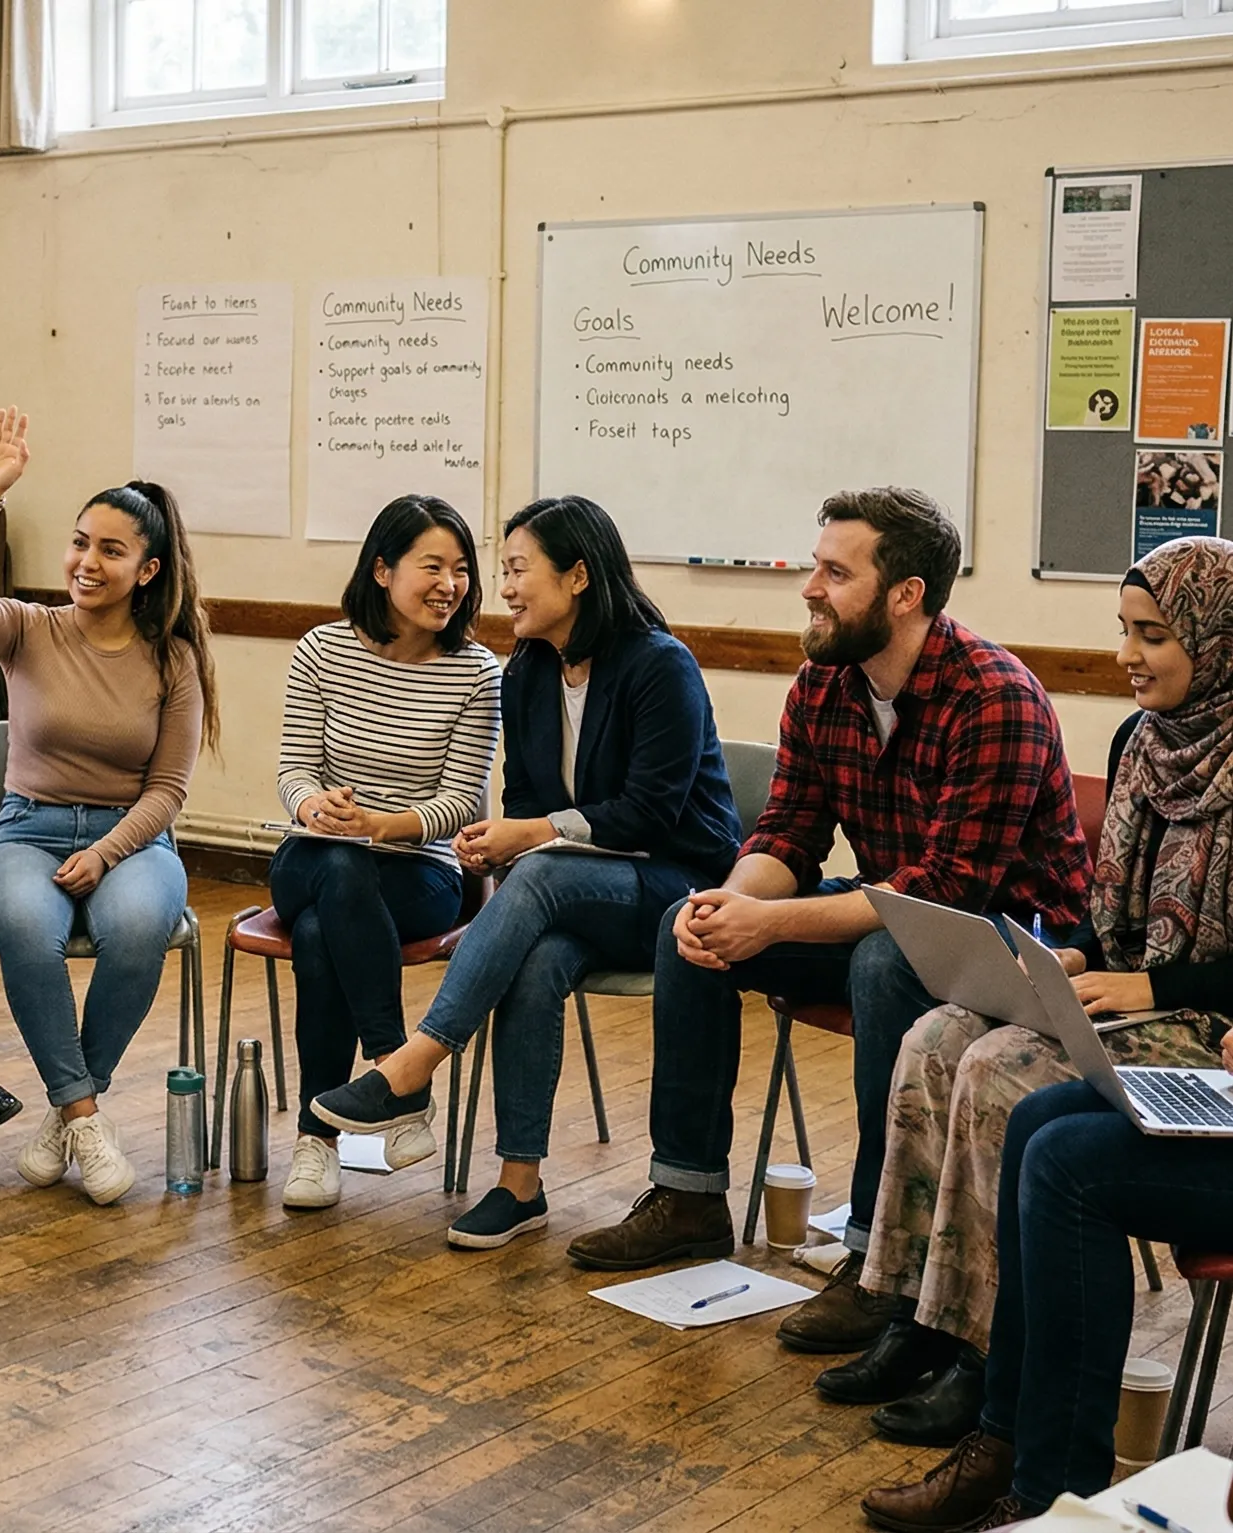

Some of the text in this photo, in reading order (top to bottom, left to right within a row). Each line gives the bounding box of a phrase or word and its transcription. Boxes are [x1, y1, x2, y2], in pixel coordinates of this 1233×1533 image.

[623, 240, 816, 287] Community Needs
[323, 291, 463, 325] Community Needs
[821, 282, 955, 329] Welcome!
[573, 306, 634, 333] Goals
[328, 332, 438, 355] Community needs
[328, 362, 375, 383] Support
[380, 361, 412, 383] goals
[416, 362, 428, 375] of
[585, 352, 734, 381] Community needs
[681, 392, 693, 404] a
[652, 422, 692, 448] taps
